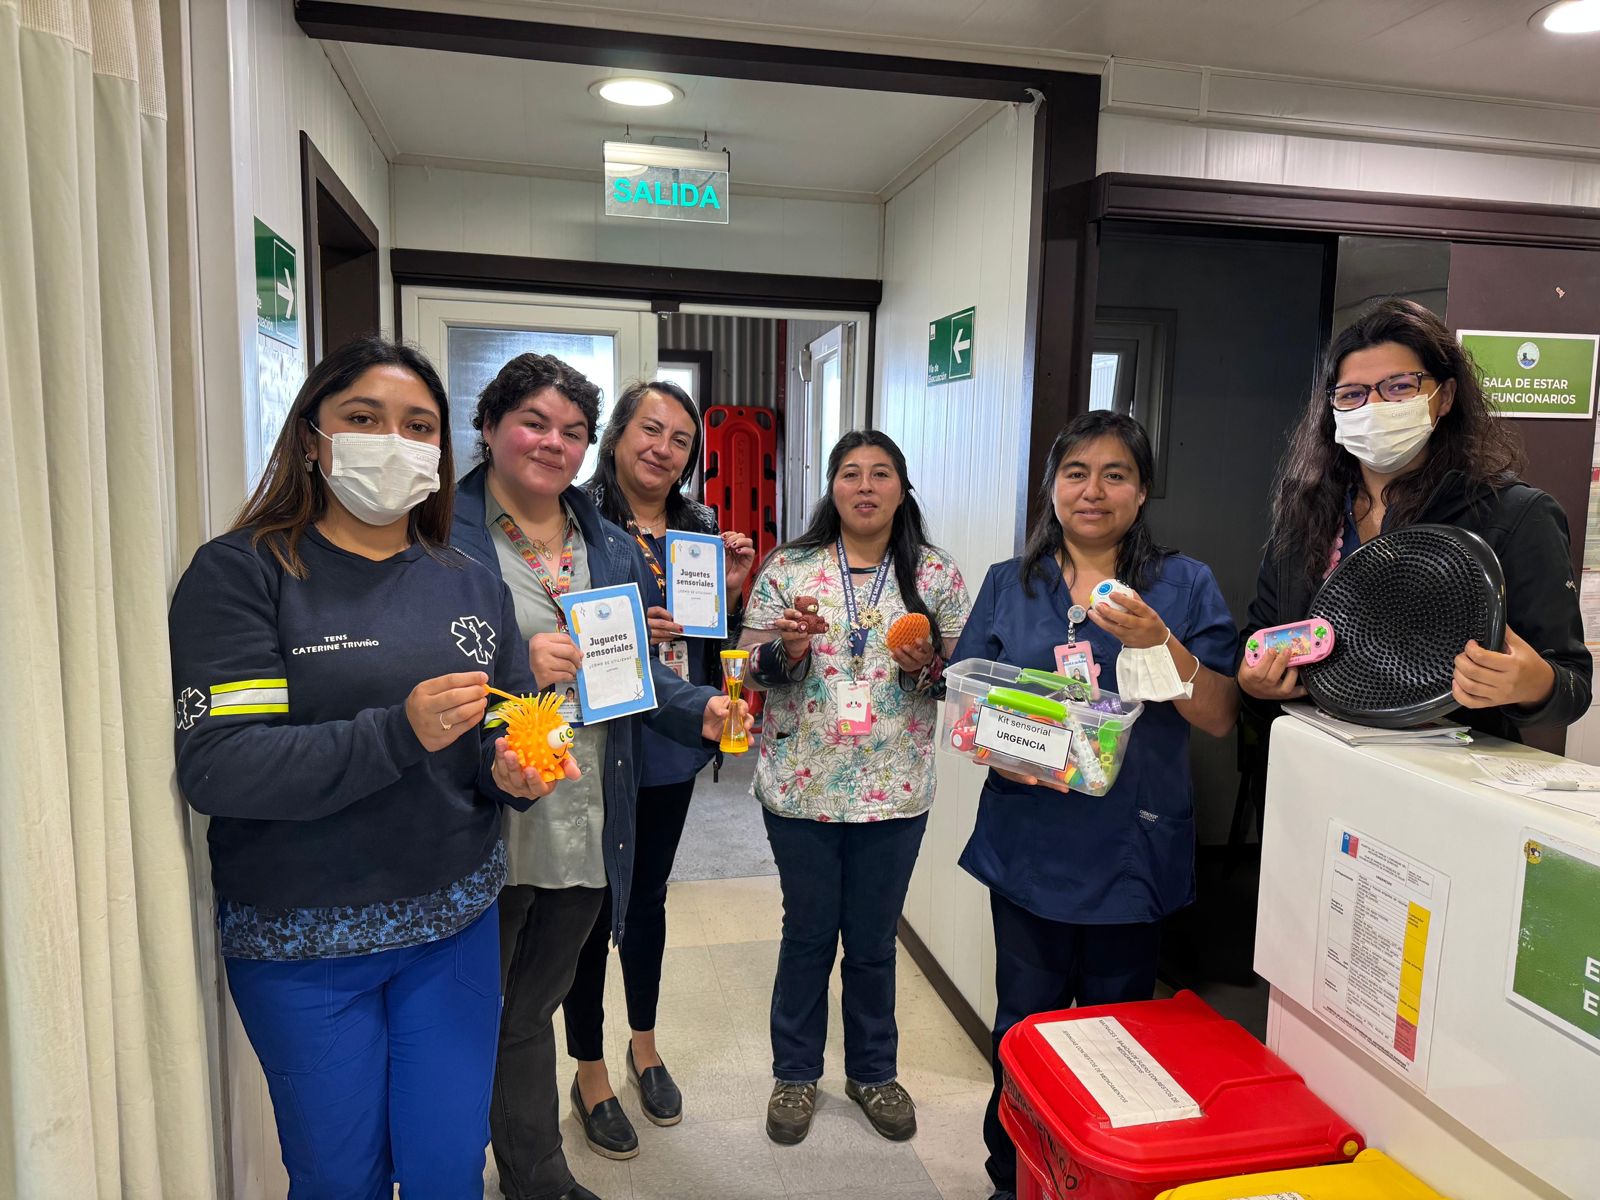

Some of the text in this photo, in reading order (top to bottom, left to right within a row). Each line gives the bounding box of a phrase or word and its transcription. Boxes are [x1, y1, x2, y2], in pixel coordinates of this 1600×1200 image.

[613, 177, 720, 209] SALIDA
[1482, 377, 1568, 390] SALA DE ESTAR
[1491, 393, 1576, 405] FUNCIONARIOS
[680, 569, 710, 579] Juguetes
[676, 578, 714, 588] sensoriales
[323, 634, 348, 643] TENS
[589, 633, 628, 647] Juguetes
[292, 639, 379, 655] CATERINE TRIVIÑO
[586, 643, 634, 659] sensoriales
[997, 714, 1051, 737] Kit sensorial
[996, 730, 1046, 752] URGENCIA
